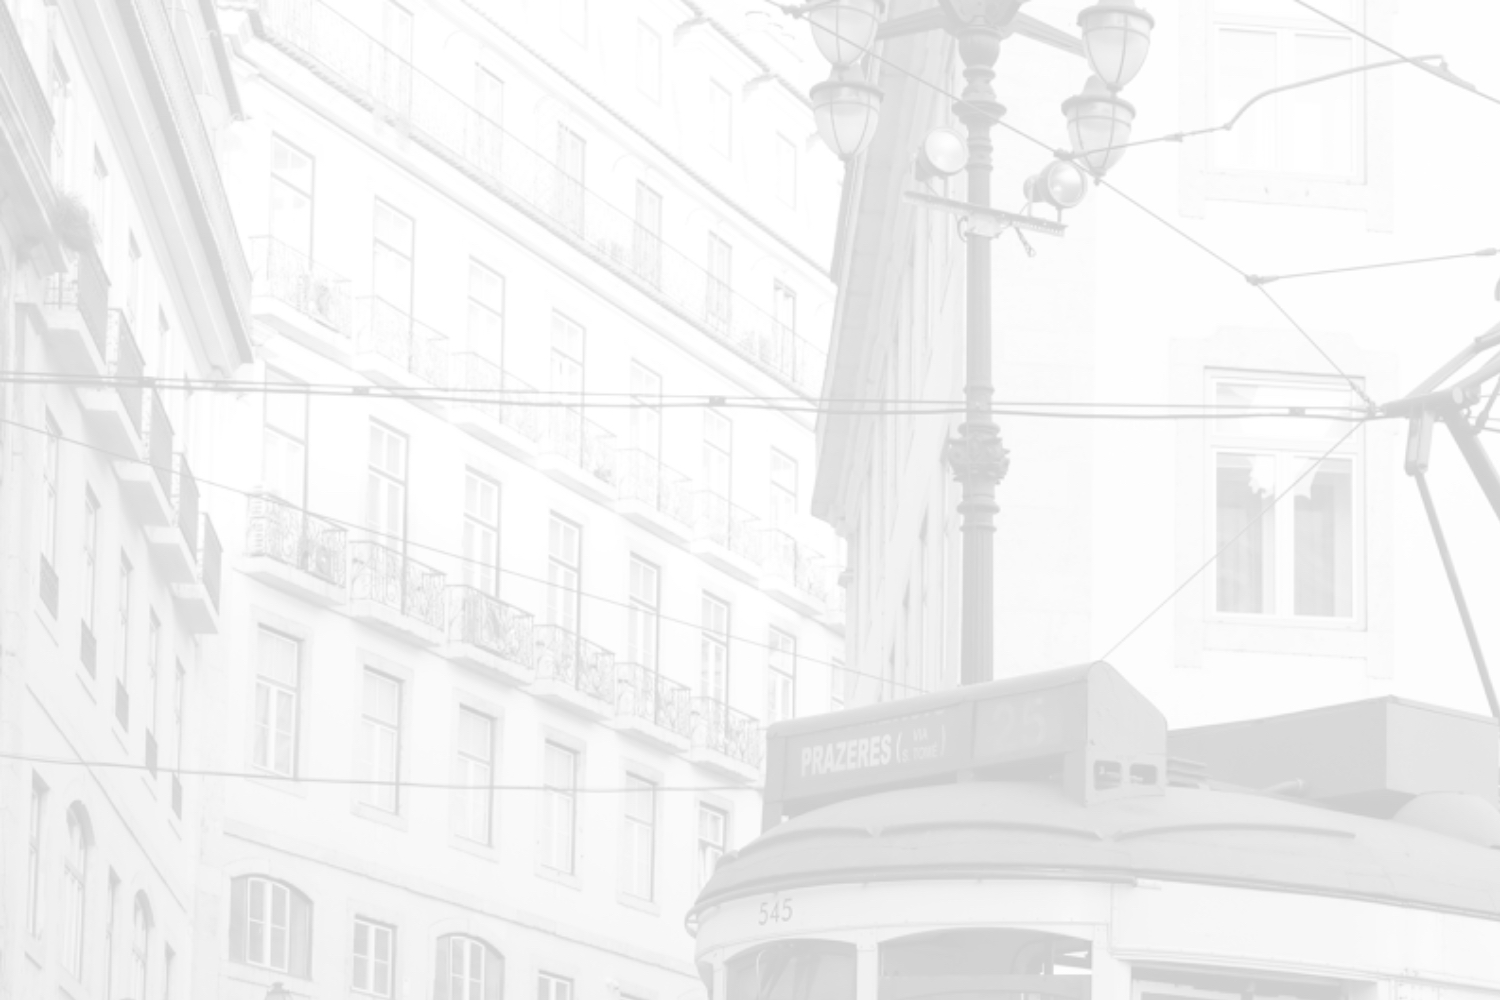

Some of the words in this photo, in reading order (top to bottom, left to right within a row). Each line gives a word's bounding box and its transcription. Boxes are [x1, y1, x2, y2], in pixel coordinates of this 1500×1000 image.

[913, 728, 929, 742] VIA
[992, 698, 1046, 751] 25
[801, 734, 892, 778] PRAZERES
[913, 741, 938, 760] TOMÉ
[758, 898, 793, 925] 545
